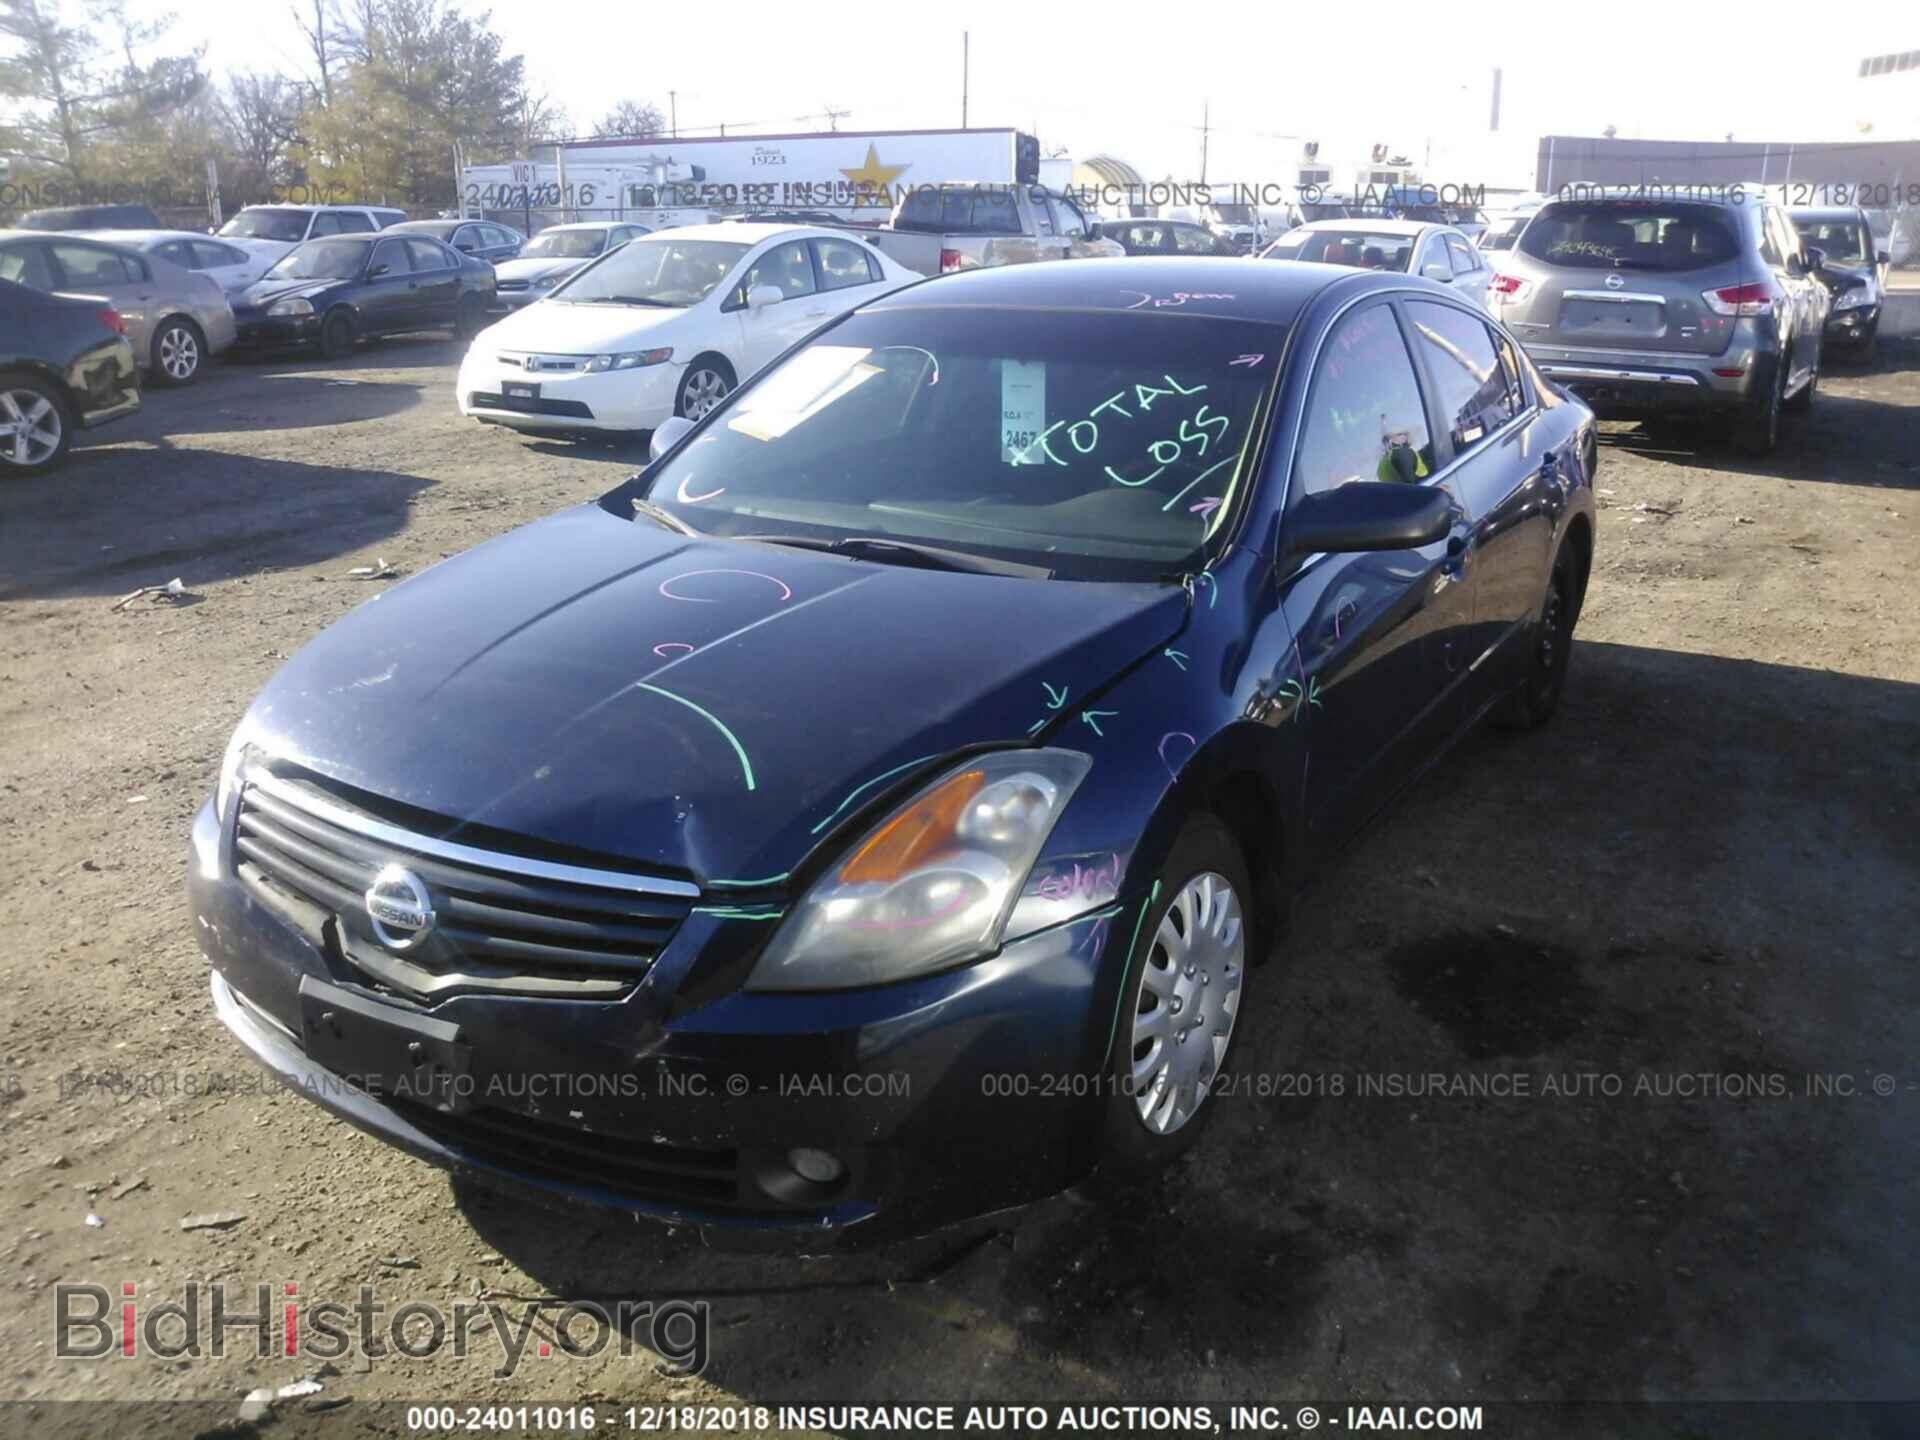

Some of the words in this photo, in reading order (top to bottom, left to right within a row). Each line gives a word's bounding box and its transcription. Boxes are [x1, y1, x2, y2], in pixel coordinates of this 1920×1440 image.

[512, 164, 530, 182] VIC
[751, 155, 786, 166] 1923
[1022, 374, 1208, 466] TOTAL
[1104, 405, 1230, 487] LOSS
